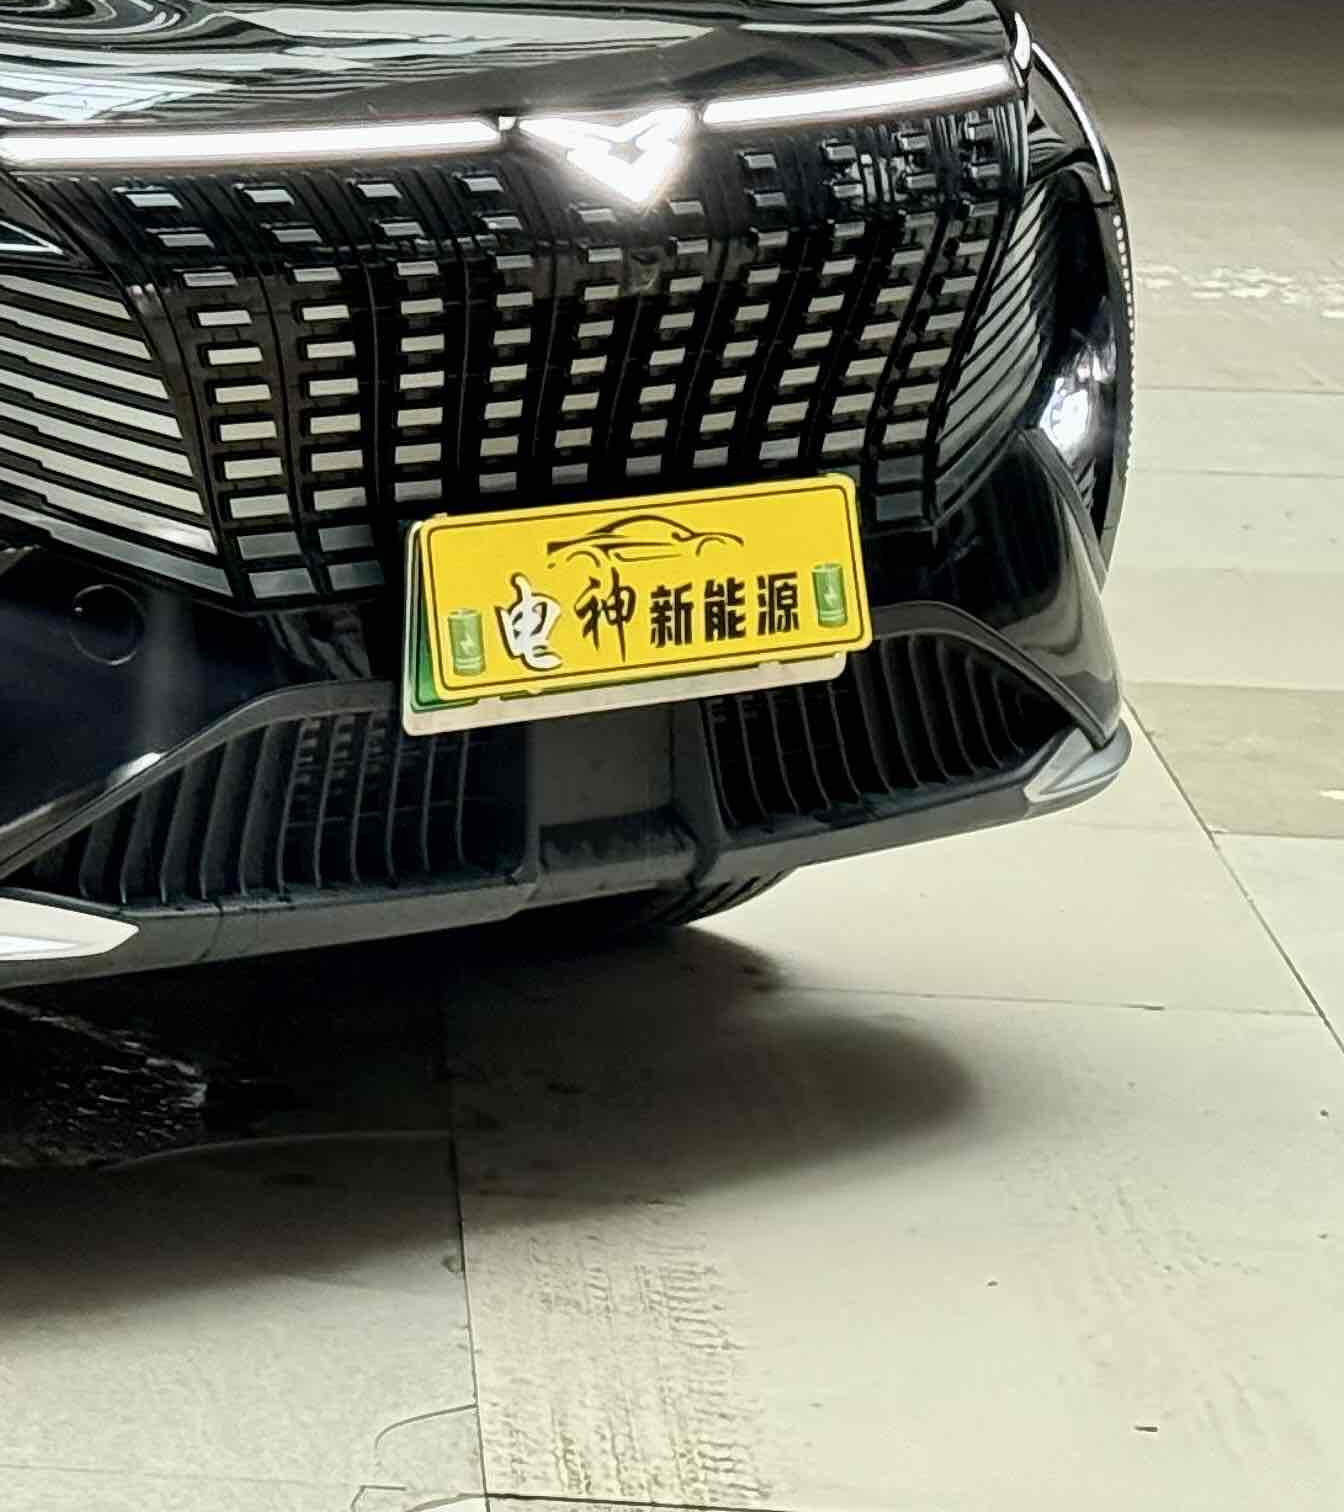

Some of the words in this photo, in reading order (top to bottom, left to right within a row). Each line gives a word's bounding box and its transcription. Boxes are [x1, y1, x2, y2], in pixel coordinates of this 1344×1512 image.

[494, 566, 802, 671] 电神新能源
